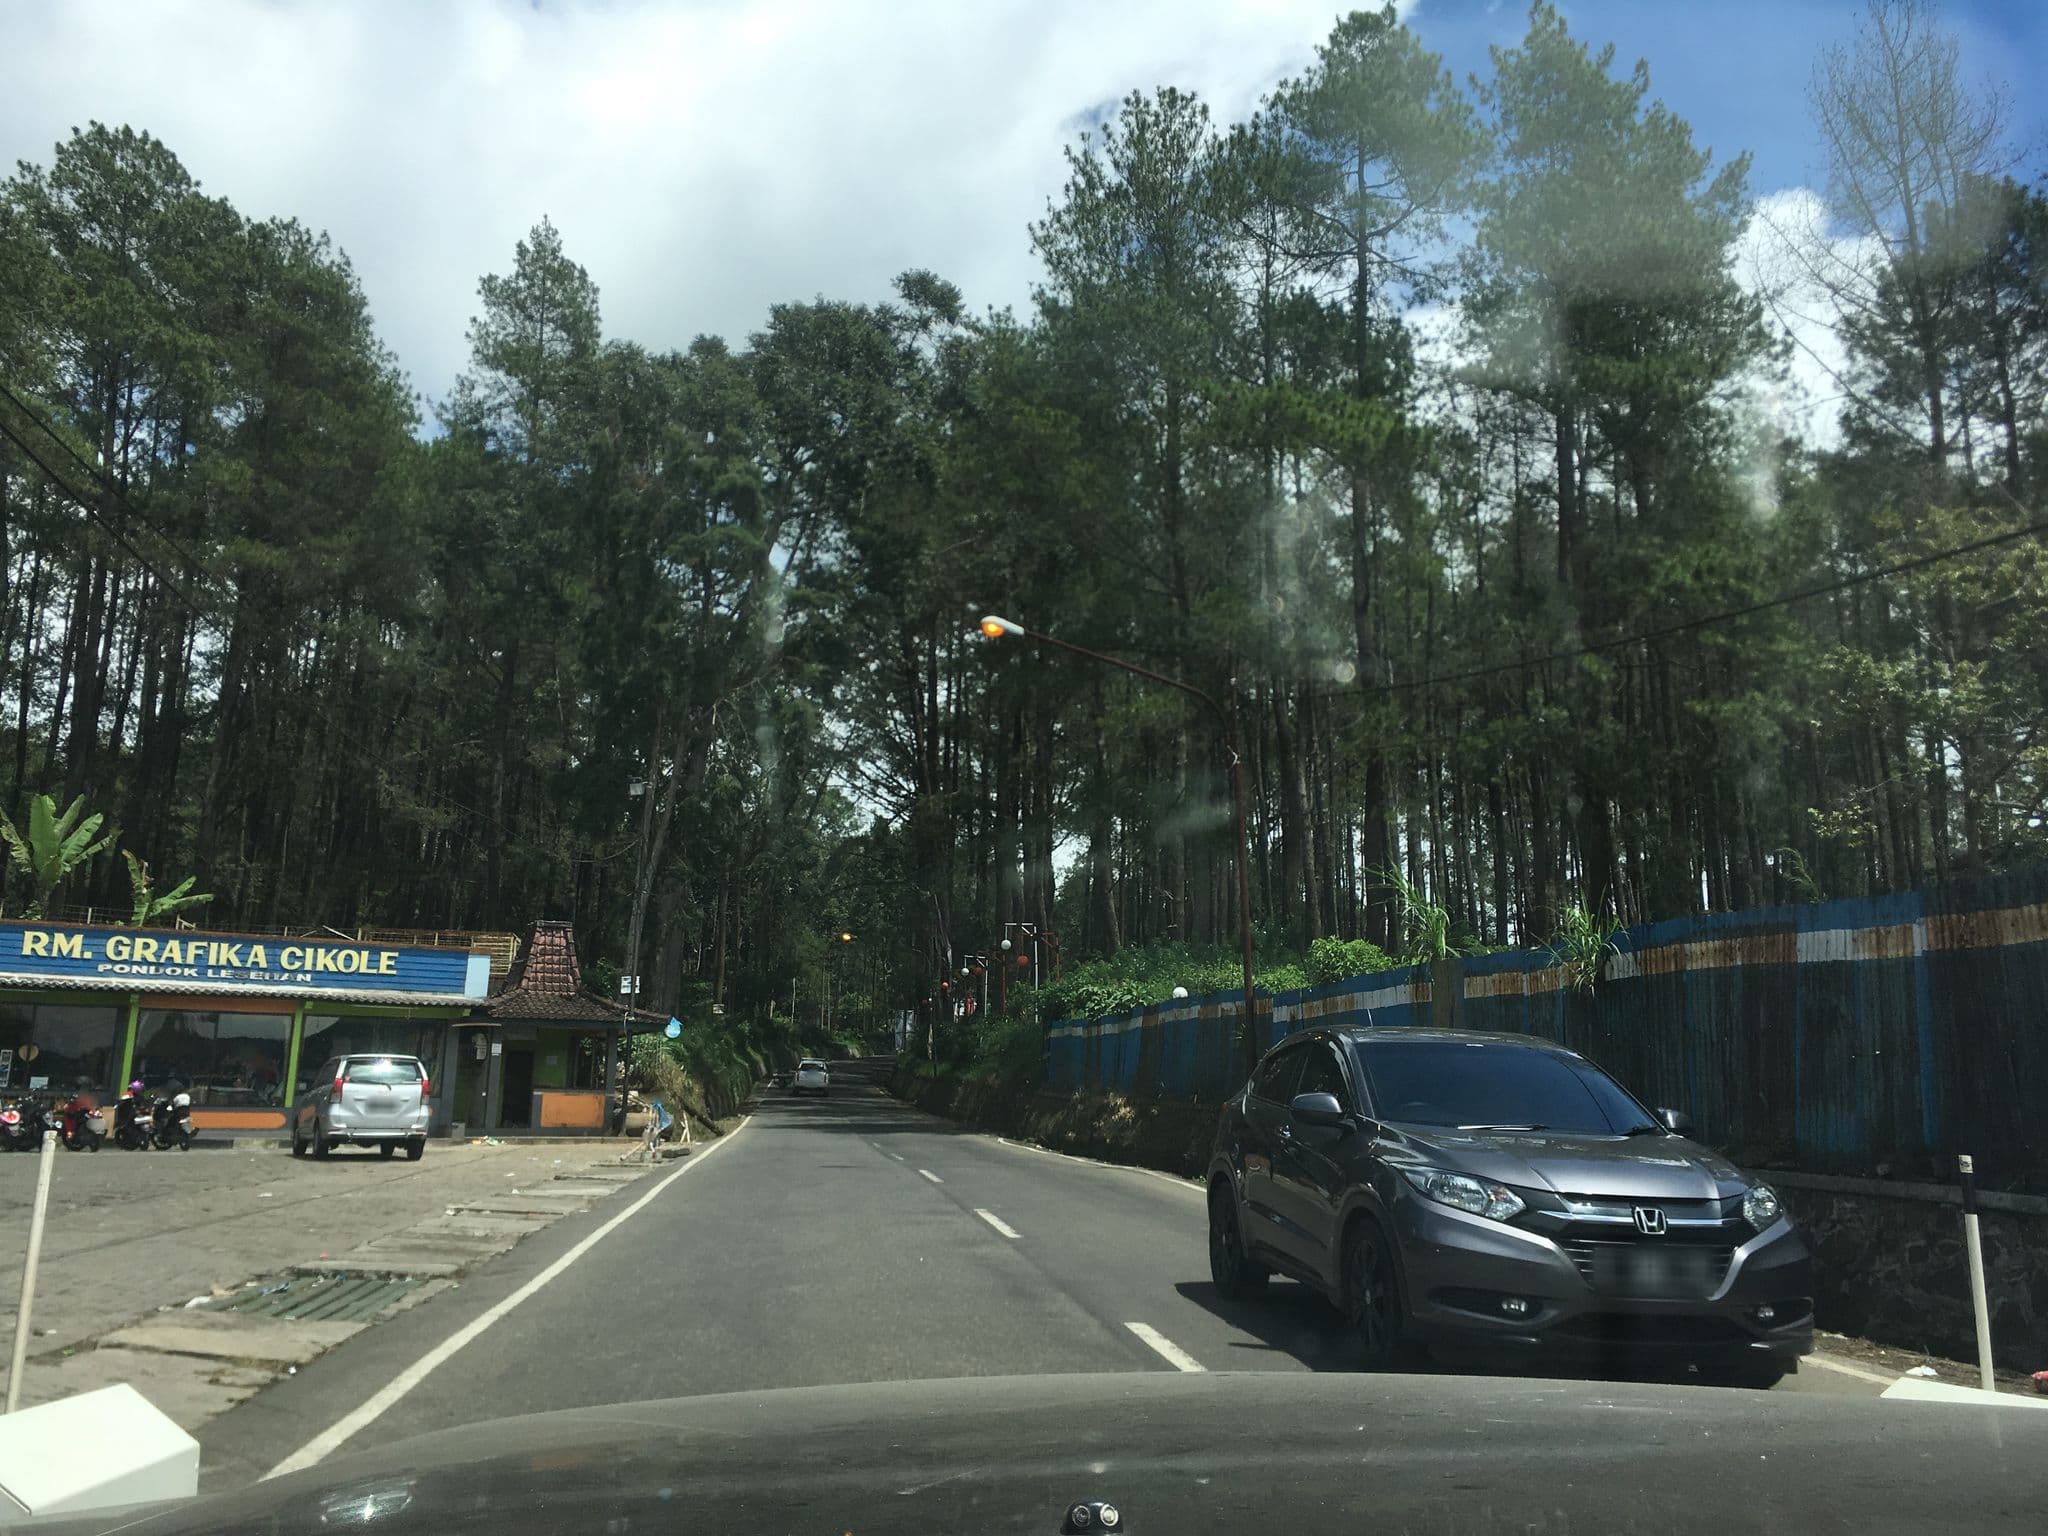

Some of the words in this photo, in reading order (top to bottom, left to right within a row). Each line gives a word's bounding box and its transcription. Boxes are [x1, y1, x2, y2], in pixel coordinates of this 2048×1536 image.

[21, 930, 93, 959] RM.
[105, 935, 268, 969] GRAFIKA
[279, 946, 399, 975] CIKOLE
